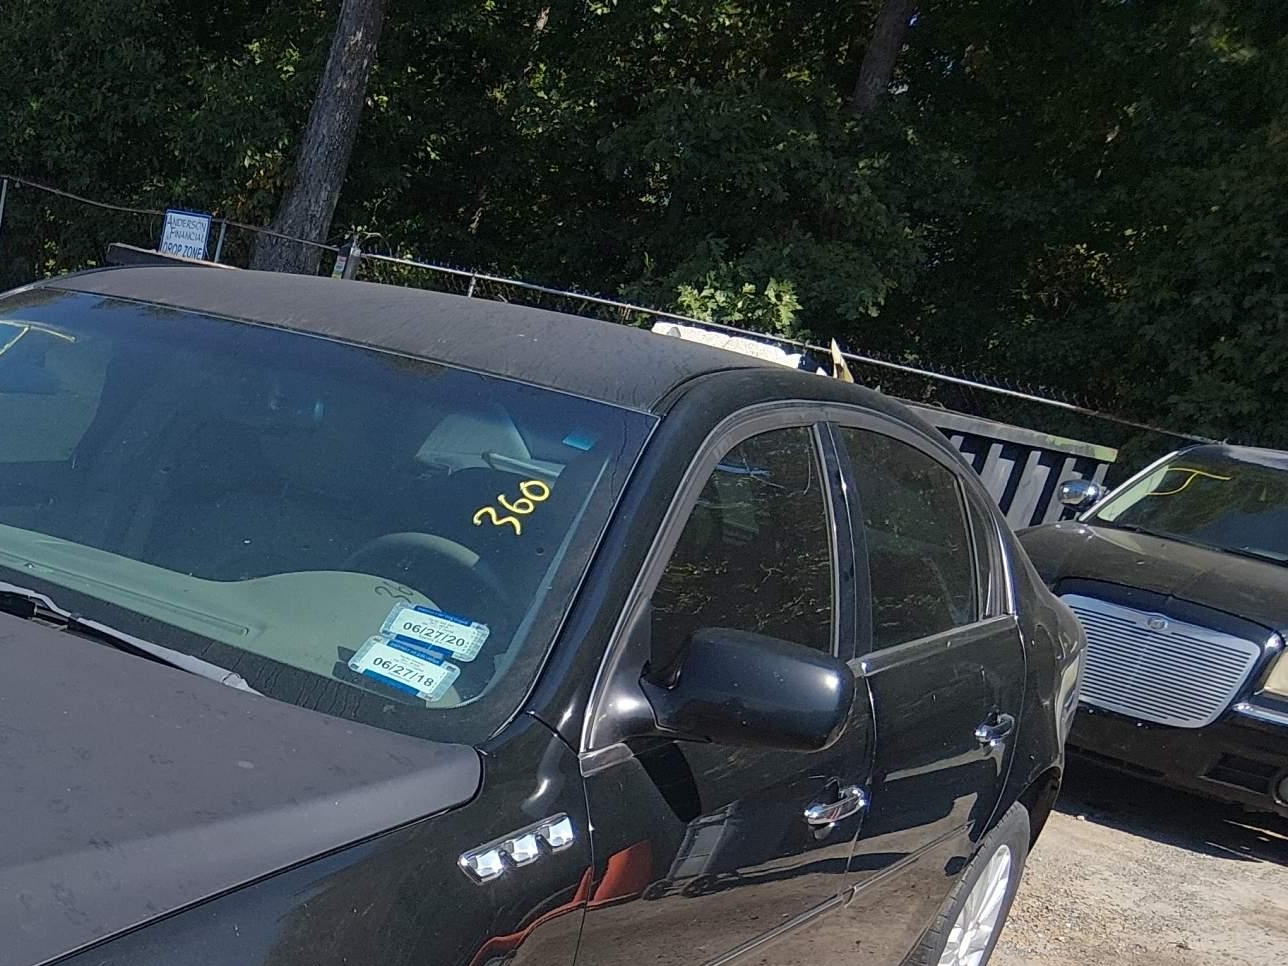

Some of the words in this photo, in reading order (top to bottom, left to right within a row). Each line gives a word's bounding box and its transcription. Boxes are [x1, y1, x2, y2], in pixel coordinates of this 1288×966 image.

[182, 245, 204, 260] ZONE
[473, 480, 550, 536] 360
[402, 621, 466, 648] 06/27/20
[372, 656, 435, 688] 06/27/18
